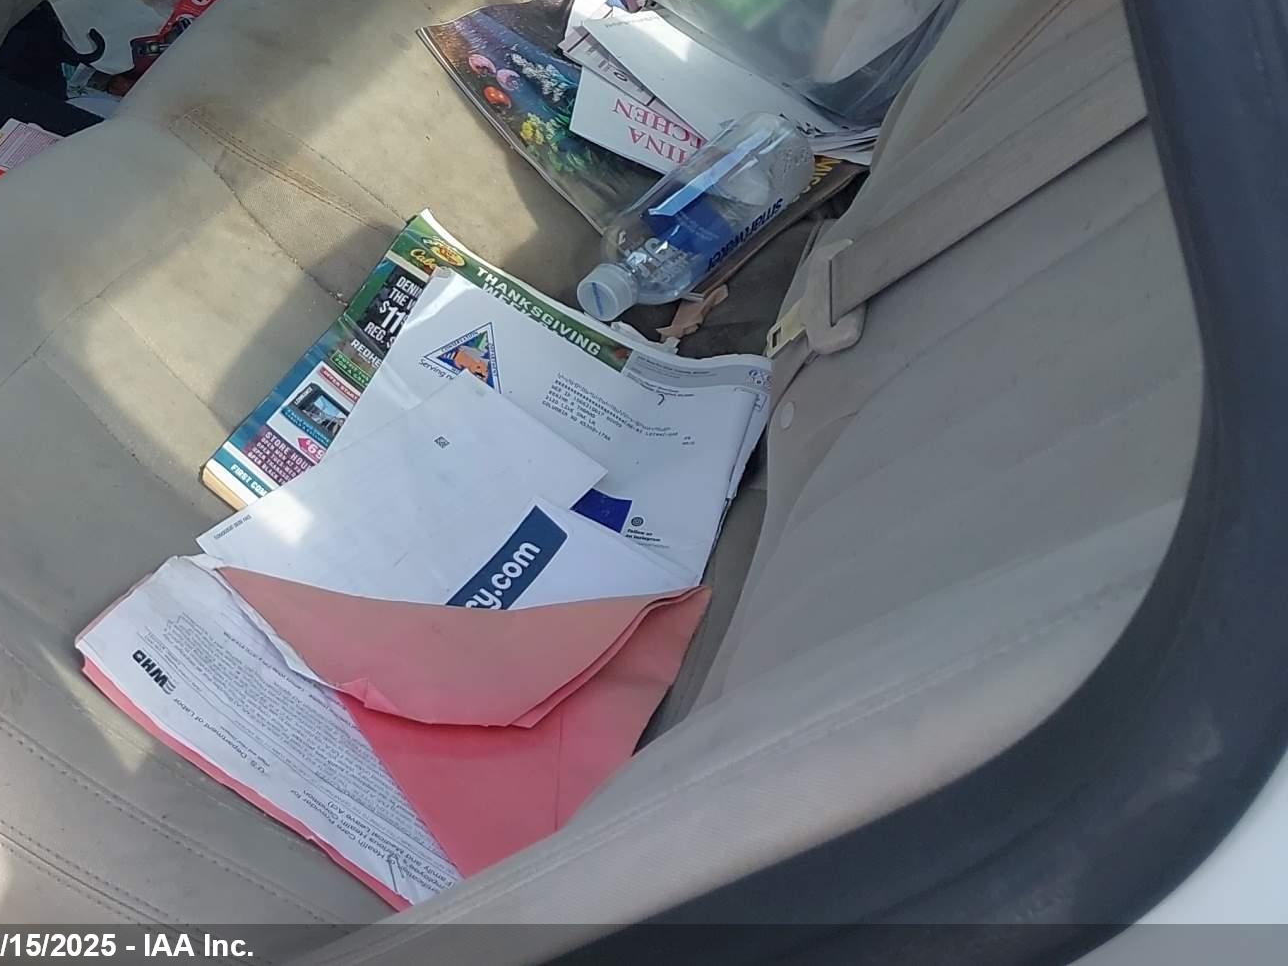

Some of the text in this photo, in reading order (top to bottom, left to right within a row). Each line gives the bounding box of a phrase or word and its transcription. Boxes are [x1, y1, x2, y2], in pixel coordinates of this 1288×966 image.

[387, 287, 408, 307] THE
[474, 264, 602, 358] THANKSGIVING
[364, 323, 385, 344] REG.
[264, 430, 291, 455] STORE
[132, 649, 169, 690] WHD
[171, 696, 196, 719] Labor
